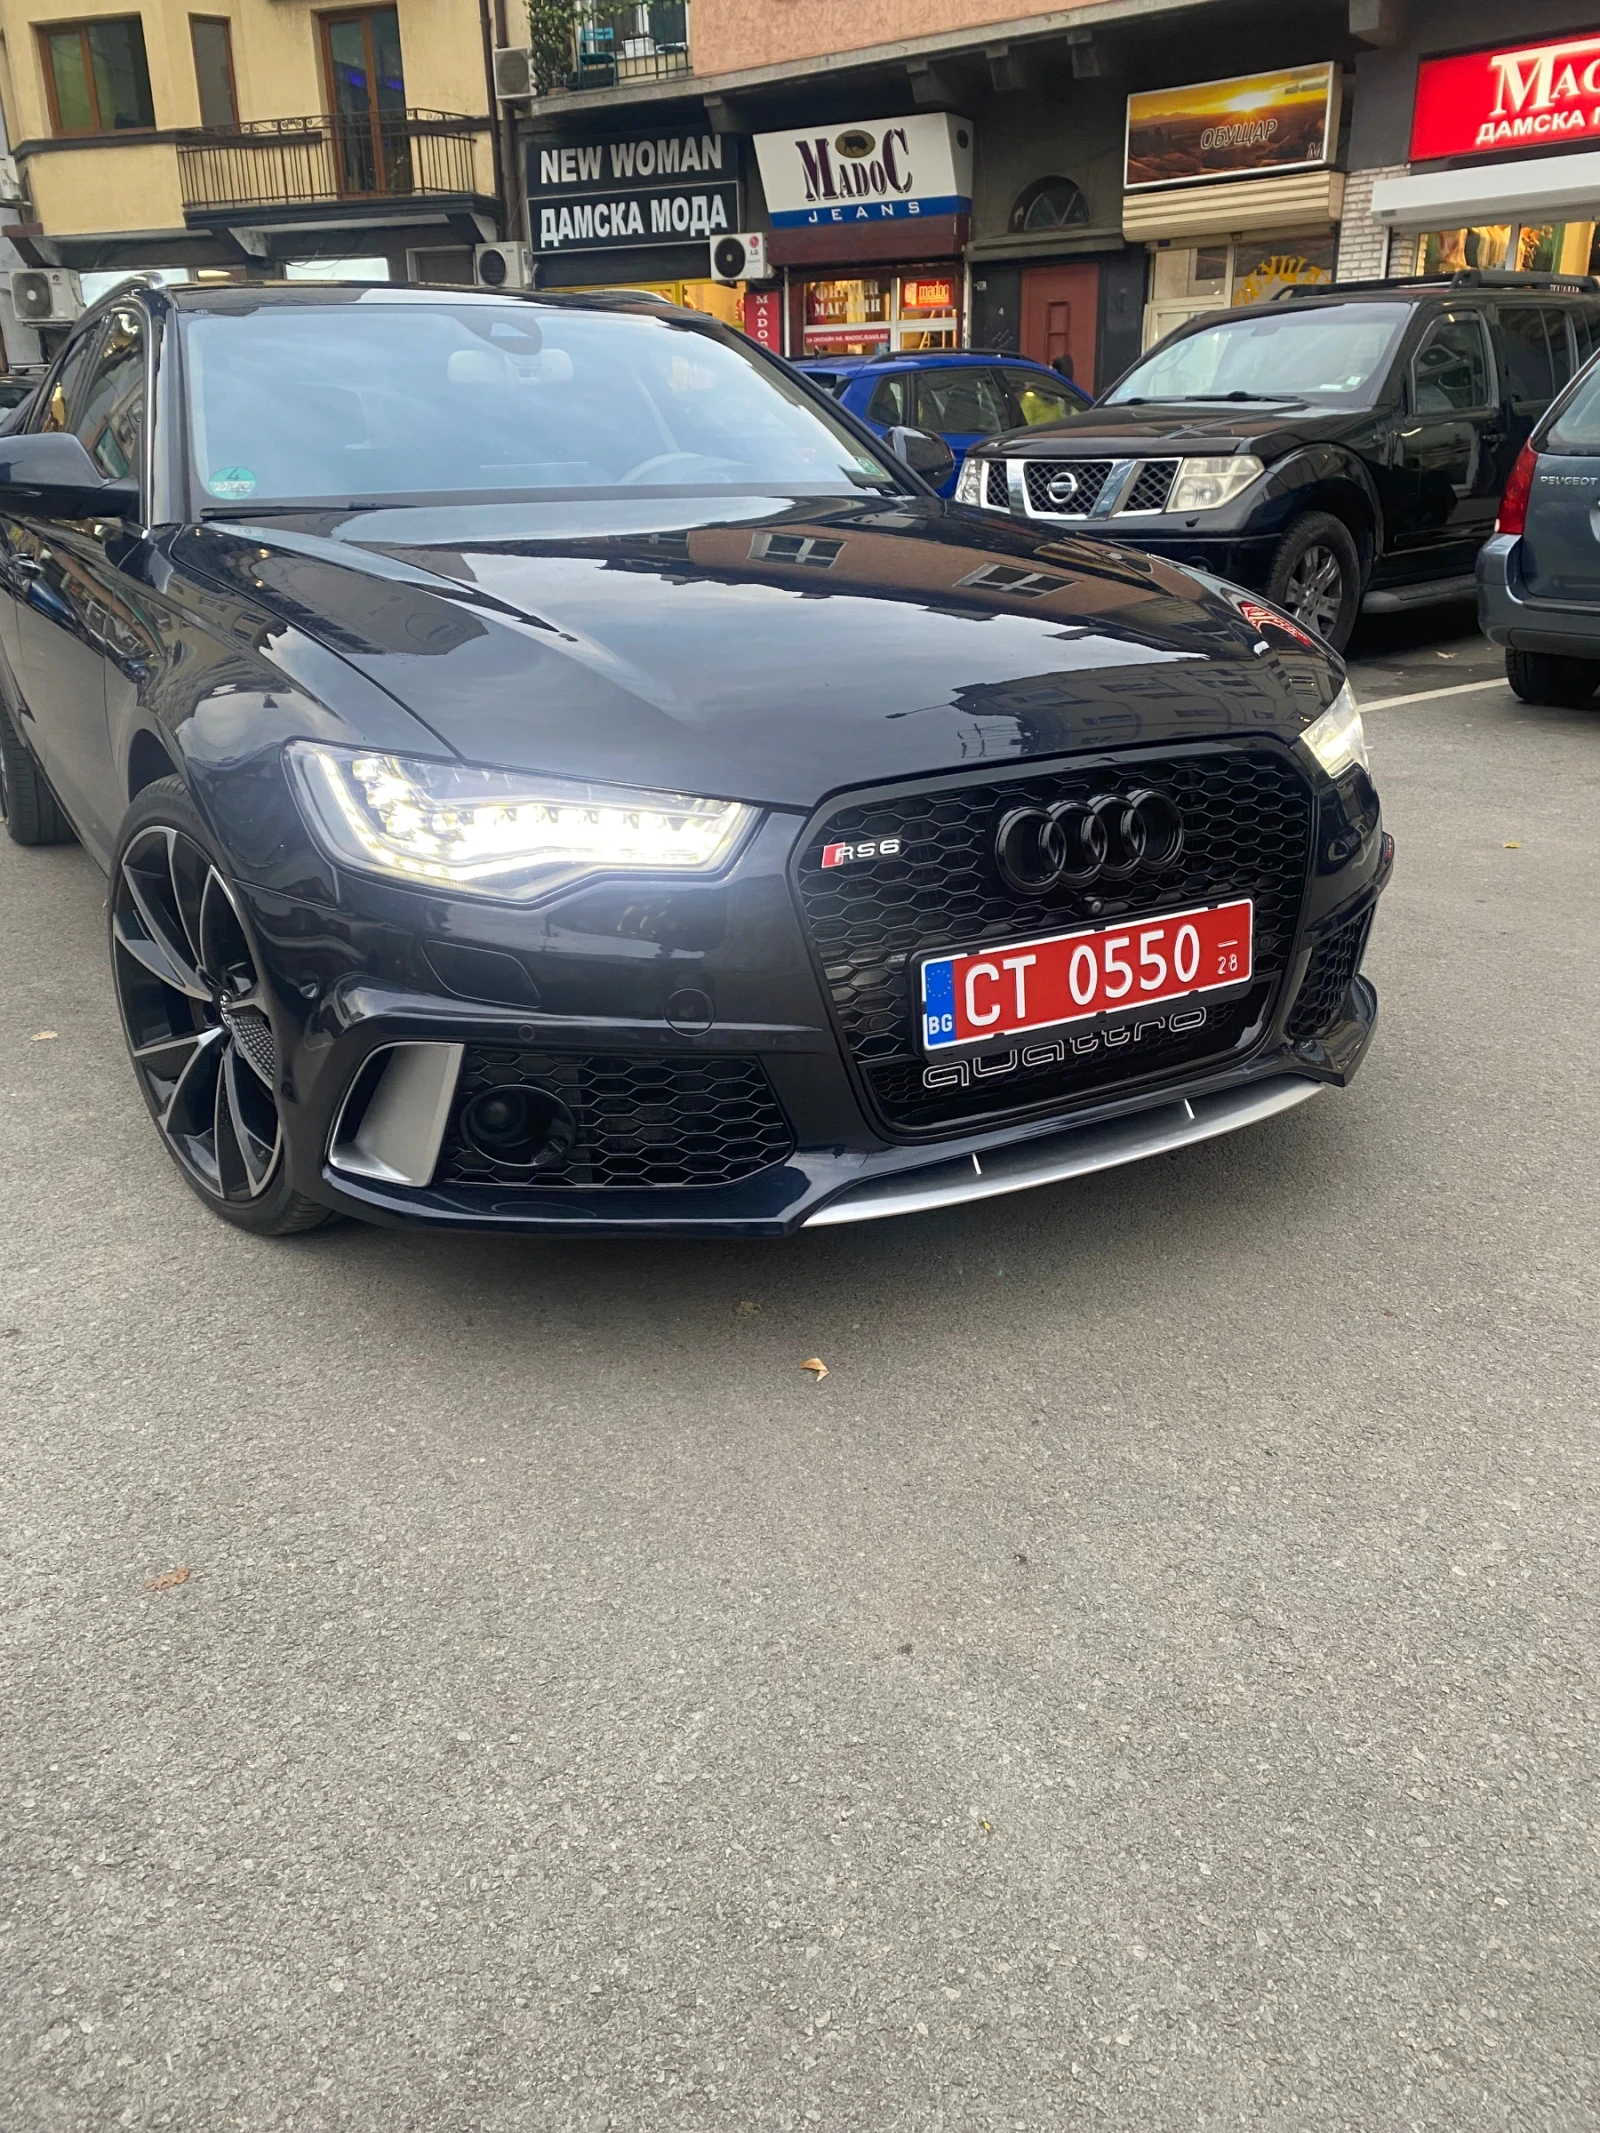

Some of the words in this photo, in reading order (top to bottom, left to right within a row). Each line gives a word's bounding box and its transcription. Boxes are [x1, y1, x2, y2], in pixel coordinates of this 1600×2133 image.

[1201, 119, 1278, 149] ОБУЩАР
[1476, 109, 1585, 145] ДАМСКА
[540, 146, 602, 184] NEW
[610, 134, 722, 178] WOMAN
[540, 201, 644, 248] ДАМСКА
[651, 194, 728, 237] МОДА
[809, 201, 920, 223] JEANS
[918, 280, 949, 297] madoc
[1540, 475, 1598, 486] PEUGEOT
[834, 839, 900, 864] RS6
[965, 954, 1036, 1027] CT
[1068, 924, 1200, 1006] 0550
[1217, 954, 1238, 975] 28
[928, 1014, 952, 1036] BG
[922, 1007, 1207, 1089] quattro
